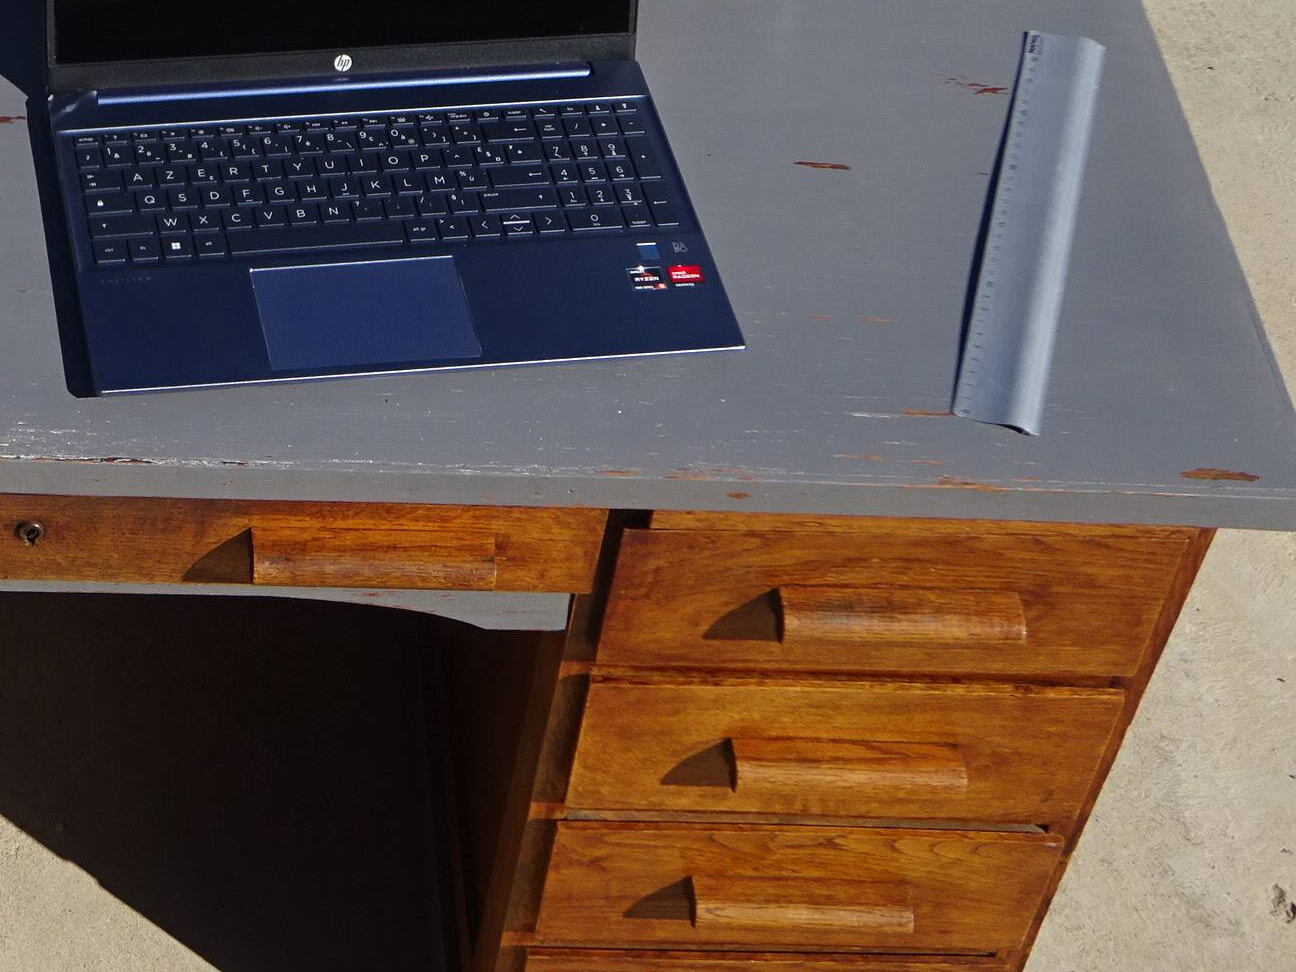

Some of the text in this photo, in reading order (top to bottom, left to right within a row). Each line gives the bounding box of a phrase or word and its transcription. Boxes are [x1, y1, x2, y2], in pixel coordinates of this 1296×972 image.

[334, 55, 352, 72] hp
[133, 174, 143, 182] A
[166, 171, 174, 179] Z
[198, 169, 205, 177] E
[229, 167, 238, 175] R
[262, 164, 270, 173] T
[293, 162, 302, 171] Y
[325, 160, 334, 169] U
[420, 154, 429, 163] P
[144, 196, 156, 204] Q
[178, 194, 187, 202] S
[210, 192, 220, 200] D
[242, 189, 250, 197] F
[274, 187, 284, 196] G
[306, 185, 316, 194] H
[341, 183, 348, 191] J
[371, 181, 381, 189] K
[404, 179, 412, 187] L
[434, 176, 446, 184] M
[164, 218, 178, 226] W
[199, 216, 208, 224] X
[232, 214, 241, 222] C
[264, 212, 273, 220] V
[296, 210, 306, 218] B
[328, 207, 338, 216] N
